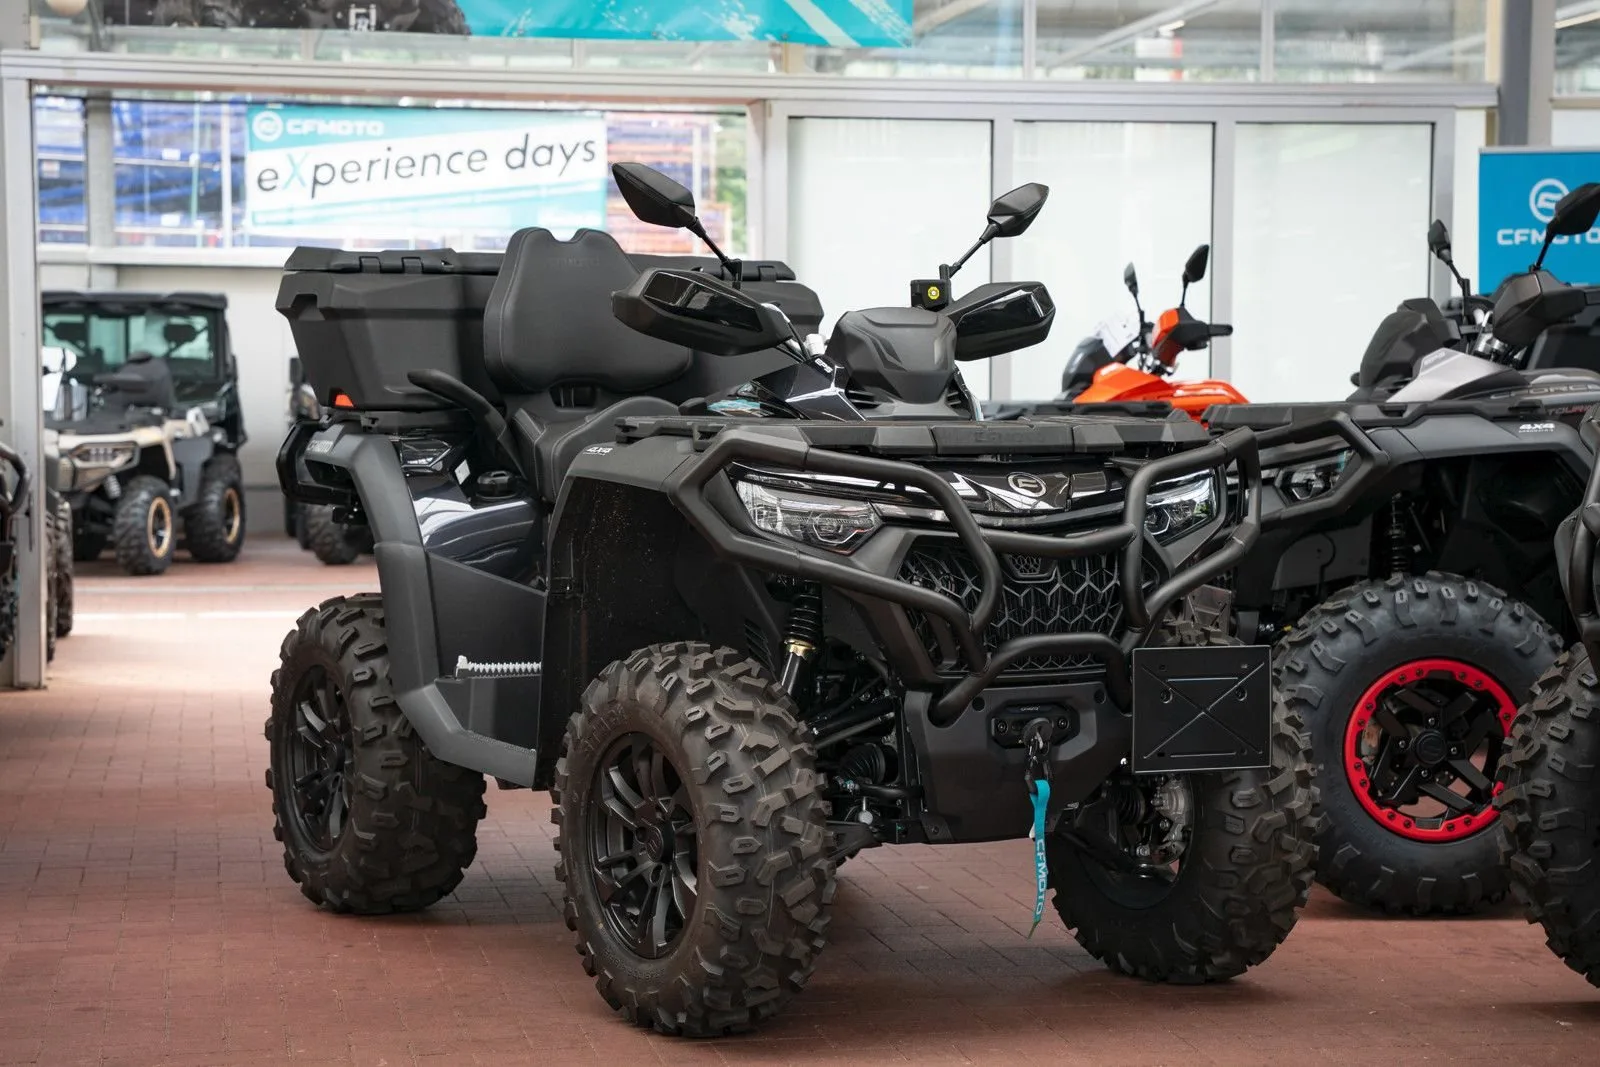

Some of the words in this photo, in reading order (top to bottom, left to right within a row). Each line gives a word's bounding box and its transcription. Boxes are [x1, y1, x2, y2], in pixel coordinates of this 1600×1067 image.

[285, 118, 385, 137] CFMOTO
[257, 146, 488, 200] eXperience
[505, 132, 596, 177] days
[814, 357, 834, 373] EPS
[1036, 838, 1048, 915] CFMOTO
